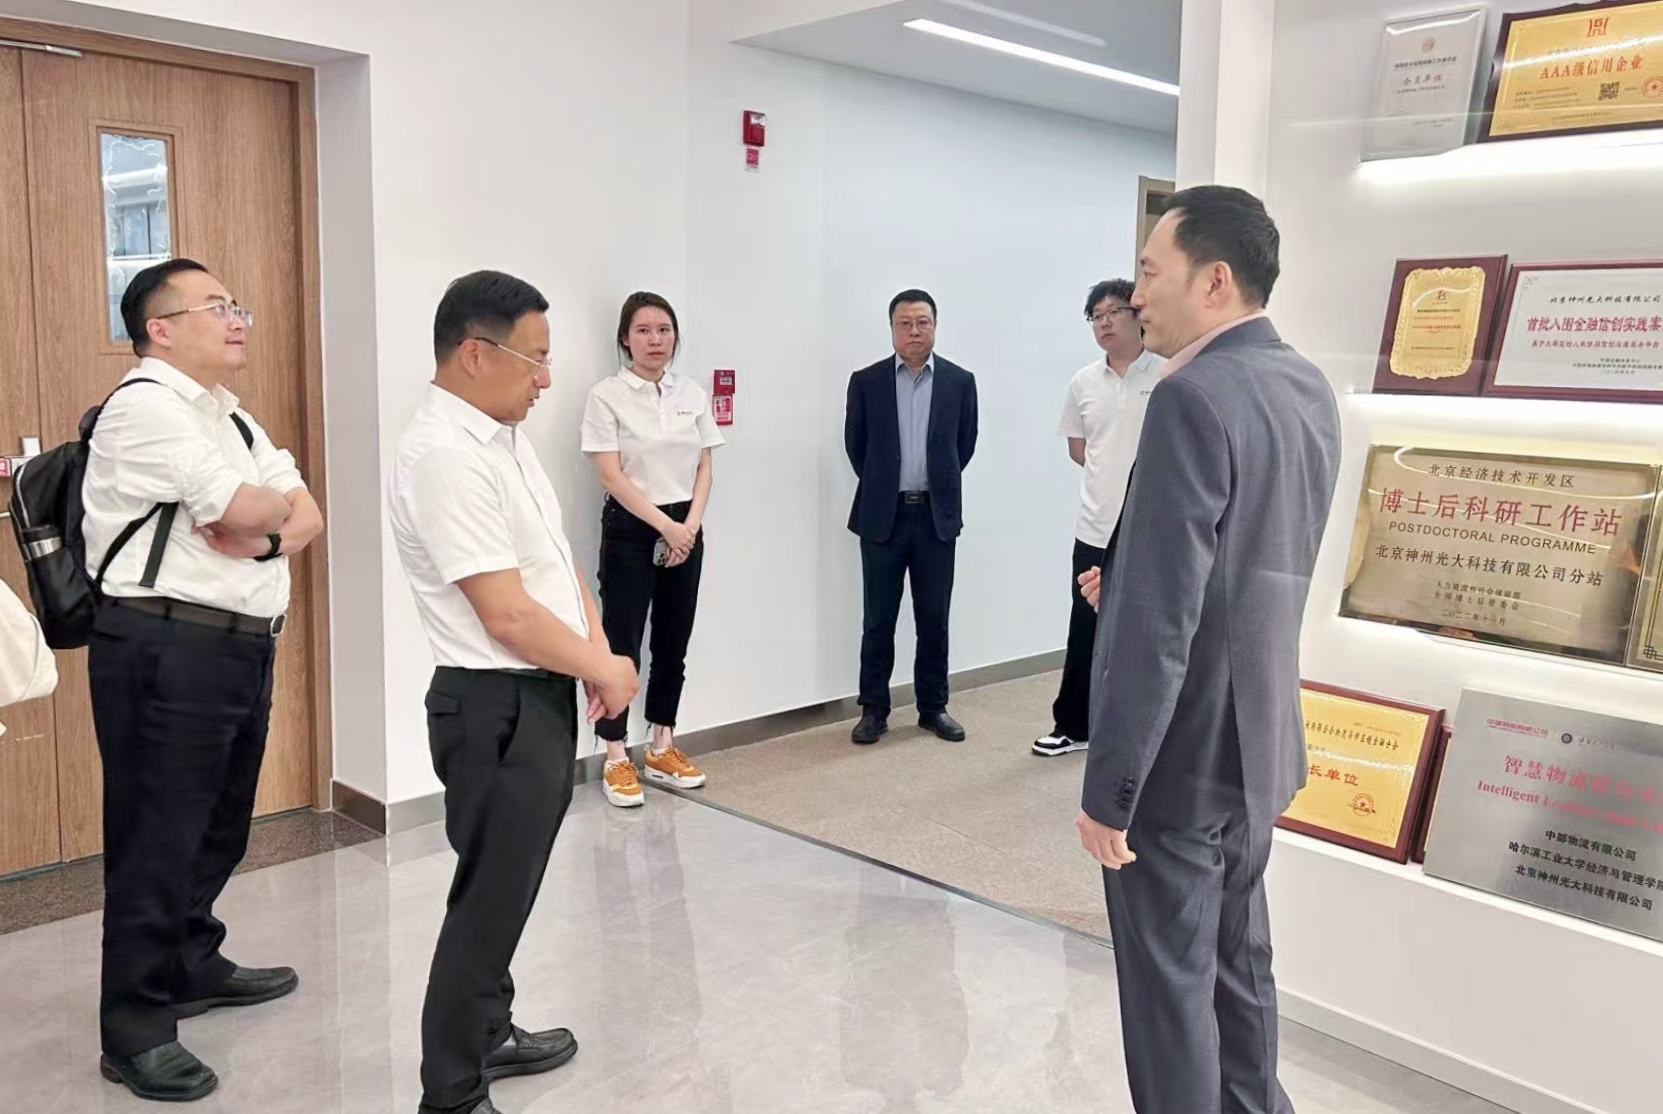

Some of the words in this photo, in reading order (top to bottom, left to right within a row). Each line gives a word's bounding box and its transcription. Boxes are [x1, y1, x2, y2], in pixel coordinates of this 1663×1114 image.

[1540, 54, 1642, 79] AAA级信用企业
[1402, 74, 1442, 86] 会员单位
[1550, 295, 1661, 304] 北京神州光大科技有限公司
[1526, 316, 1663, 332] 首批入围金融信创实践案
[1428, 464, 1575, 488] 北京经济技术开发区
[1379, 488, 1622, 536] 博士后科研工作站
[1389, 521, 1495, 543] POSTDOCTORAL
[1501, 534, 1596, 554] PROGRAMME
[1375, 545, 1604, 586] 北京神州光大科技有限公司分站
[1434, 591, 1519, 611] 全国博士后管委会
[1478, 780, 1539, 803] Intelligent
[1545, 830, 1637, 861] 中都物流有限公司
[1508, 841, 1663, 891] 哈尔滨工业大学经济与管理学院
[1515, 865, 1653, 910] 北京神州光大科技有限公司
